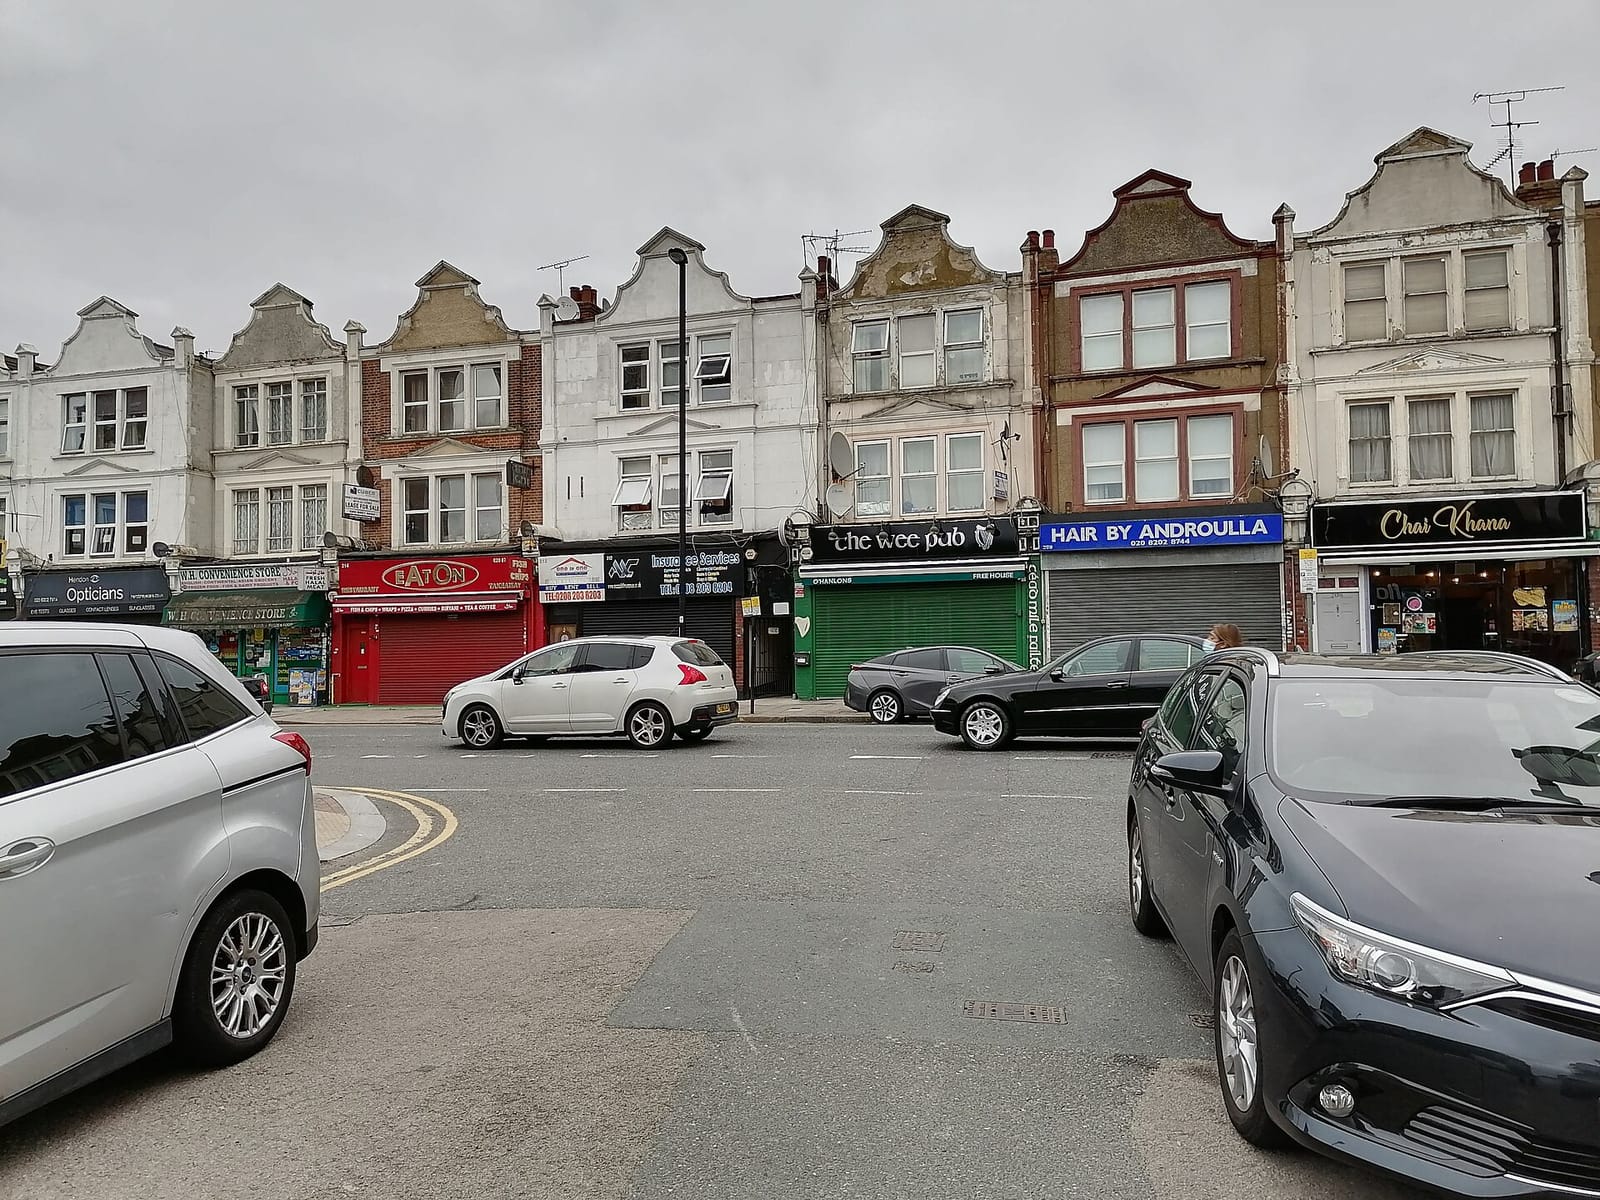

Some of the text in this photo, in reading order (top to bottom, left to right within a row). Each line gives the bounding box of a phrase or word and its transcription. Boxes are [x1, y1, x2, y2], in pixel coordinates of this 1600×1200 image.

[1380, 500, 1511, 540] Chai Khana
[834, 526, 966, 552] the wee pub
[1051, 519, 1268, 543] HAIR BY ANDROULLA
[652, 555, 698, 568] Insurace
[700, 551, 740, 566] Services
[180, 567, 281, 581] W.H. CONVENIENCE STORE
[395, 564, 466, 587] EATON
[67, 587, 124, 603] Opticians
[696, 582, 711, 594] 203
[255, 609, 285, 620] STORE
